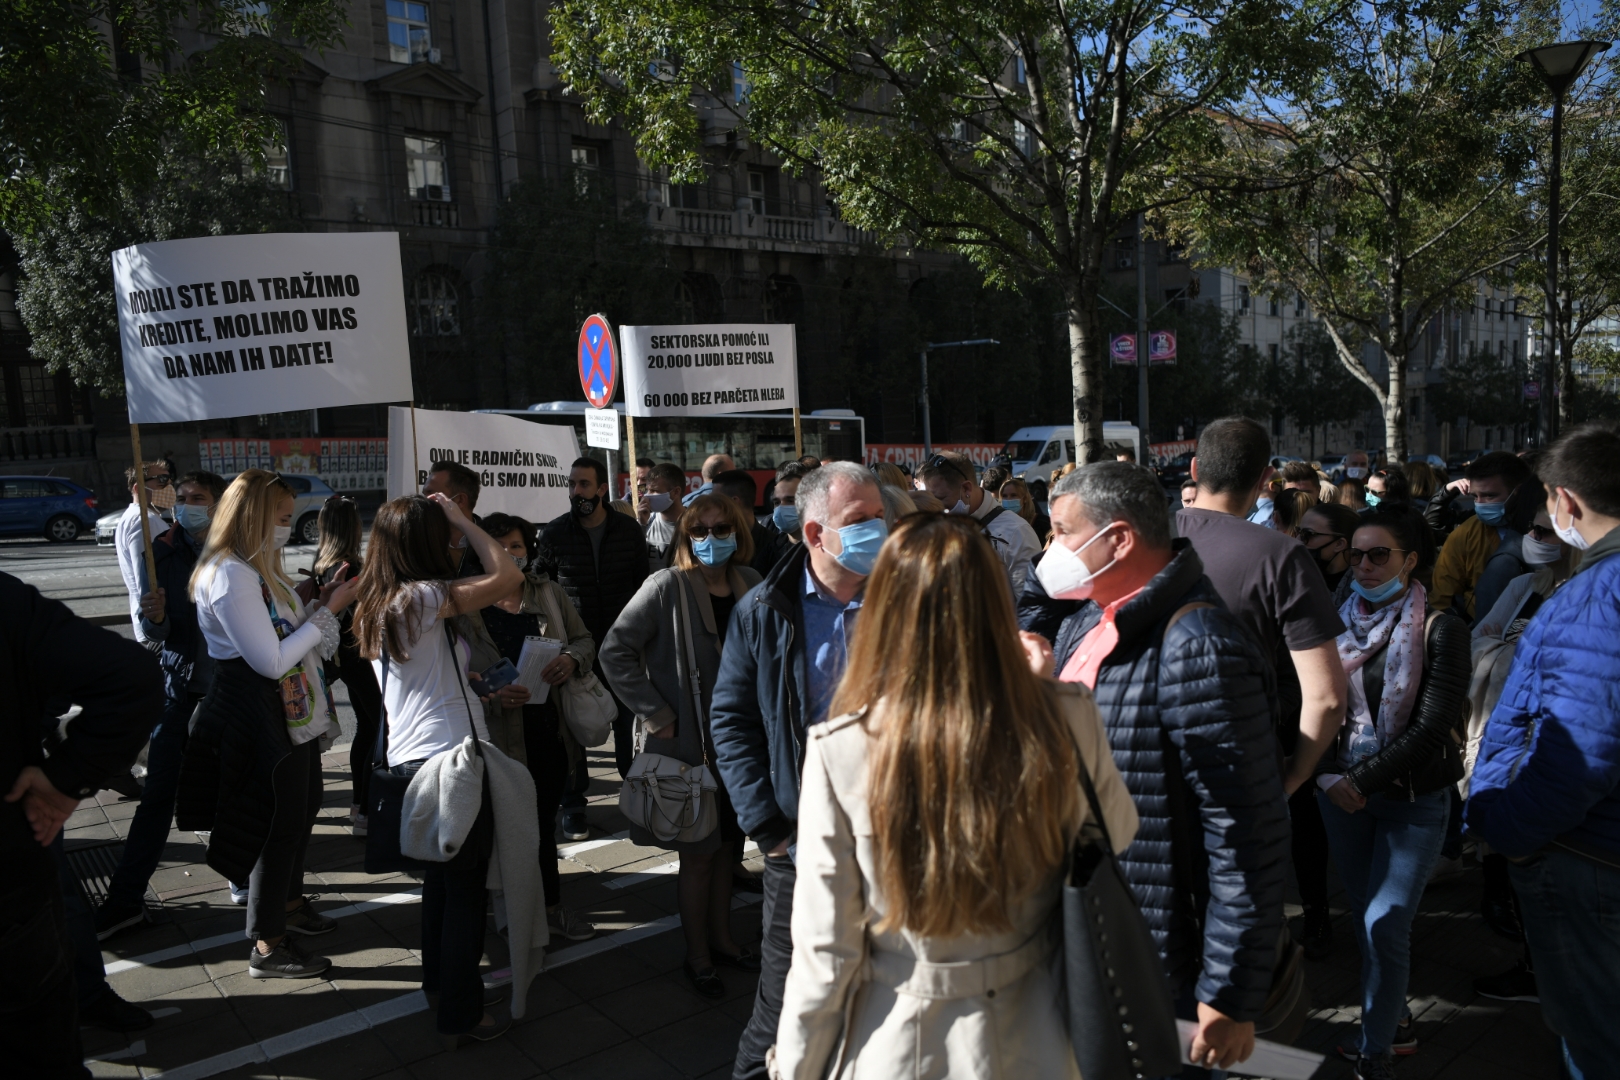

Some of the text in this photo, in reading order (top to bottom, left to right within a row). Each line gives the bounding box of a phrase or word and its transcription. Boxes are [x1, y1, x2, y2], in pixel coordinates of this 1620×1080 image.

[128, 271, 360, 315] MOLILI STE DA TRAŽIMO
[139, 306, 358, 348] KREDITE, MOLIMO VAS
[650, 331, 770, 350] SEKTORSKA POMOĆ ILI
[163, 341, 334, 379] DA NAM IH DATE!
[648, 351, 774, 370] 20,000 LJUDI BEZ POSLA
[644, 387, 785, 408] 60 000 BEZ PARČETA HLEBA
[430, 448, 454, 463] OVO
[458, 450, 469, 465] JE
[472, 448, 534, 467] RADNIČKI
[497, 472, 527, 487] SMO
[530, 473, 546, 487] NA
